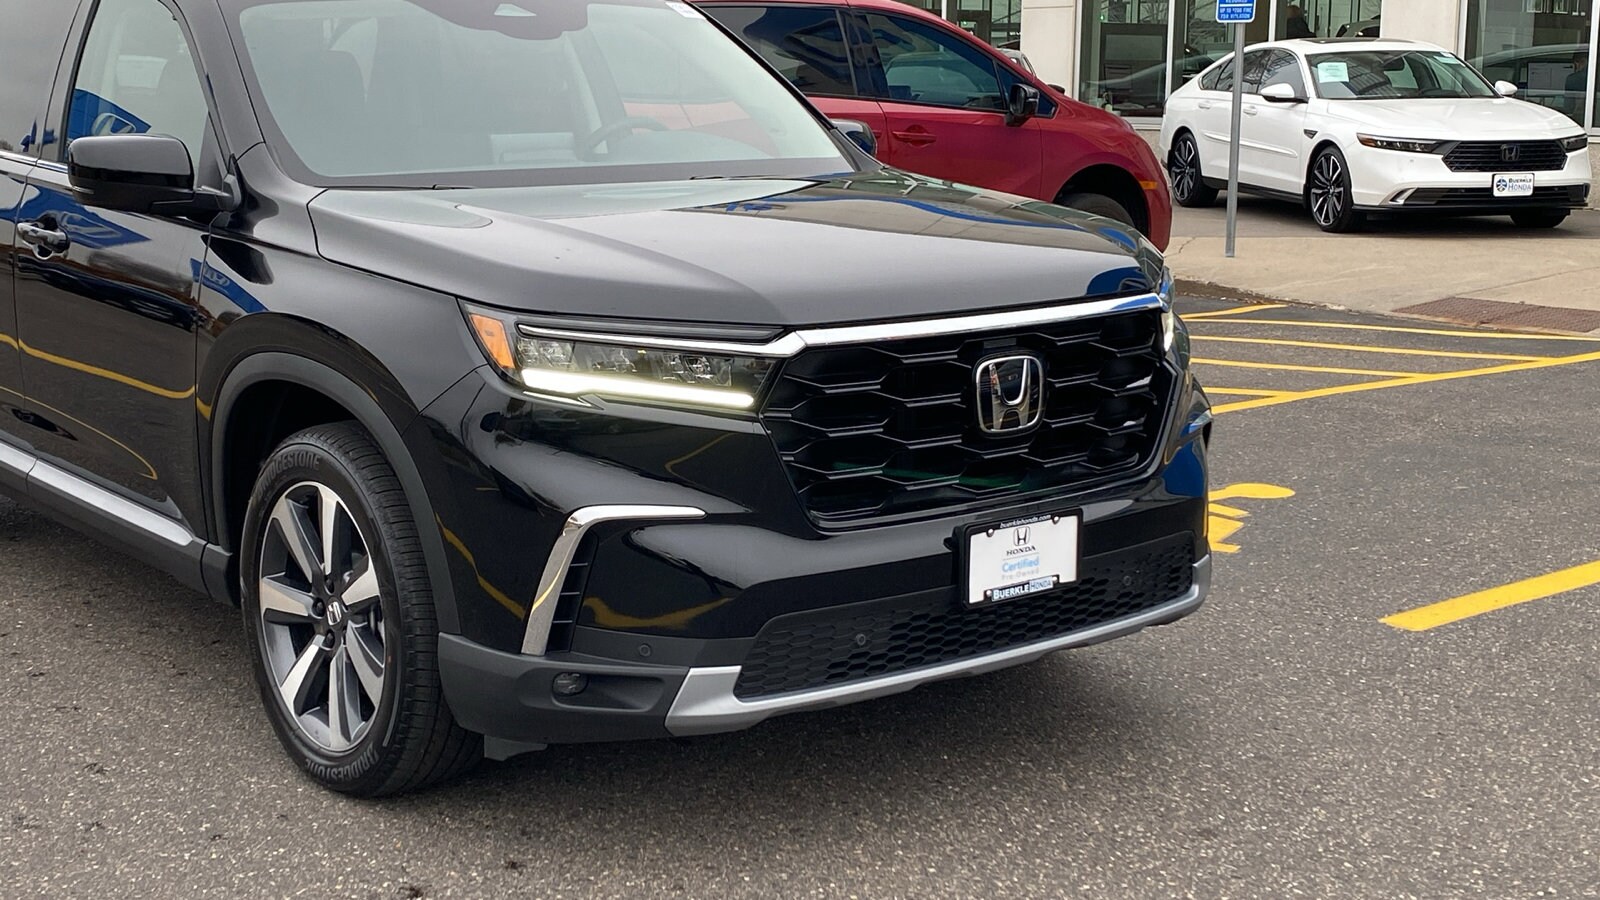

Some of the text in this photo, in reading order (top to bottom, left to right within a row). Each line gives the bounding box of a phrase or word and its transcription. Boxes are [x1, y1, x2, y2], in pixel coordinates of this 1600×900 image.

[1508, 183, 1532, 191] HONDA
[1000, 514, 1051, 529] buerklehonda.com
[1006, 545, 1036, 556] HONDA
[1002, 556, 1040, 573] Certified
[993, 579, 1052, 600] BUERKLE HONDA
